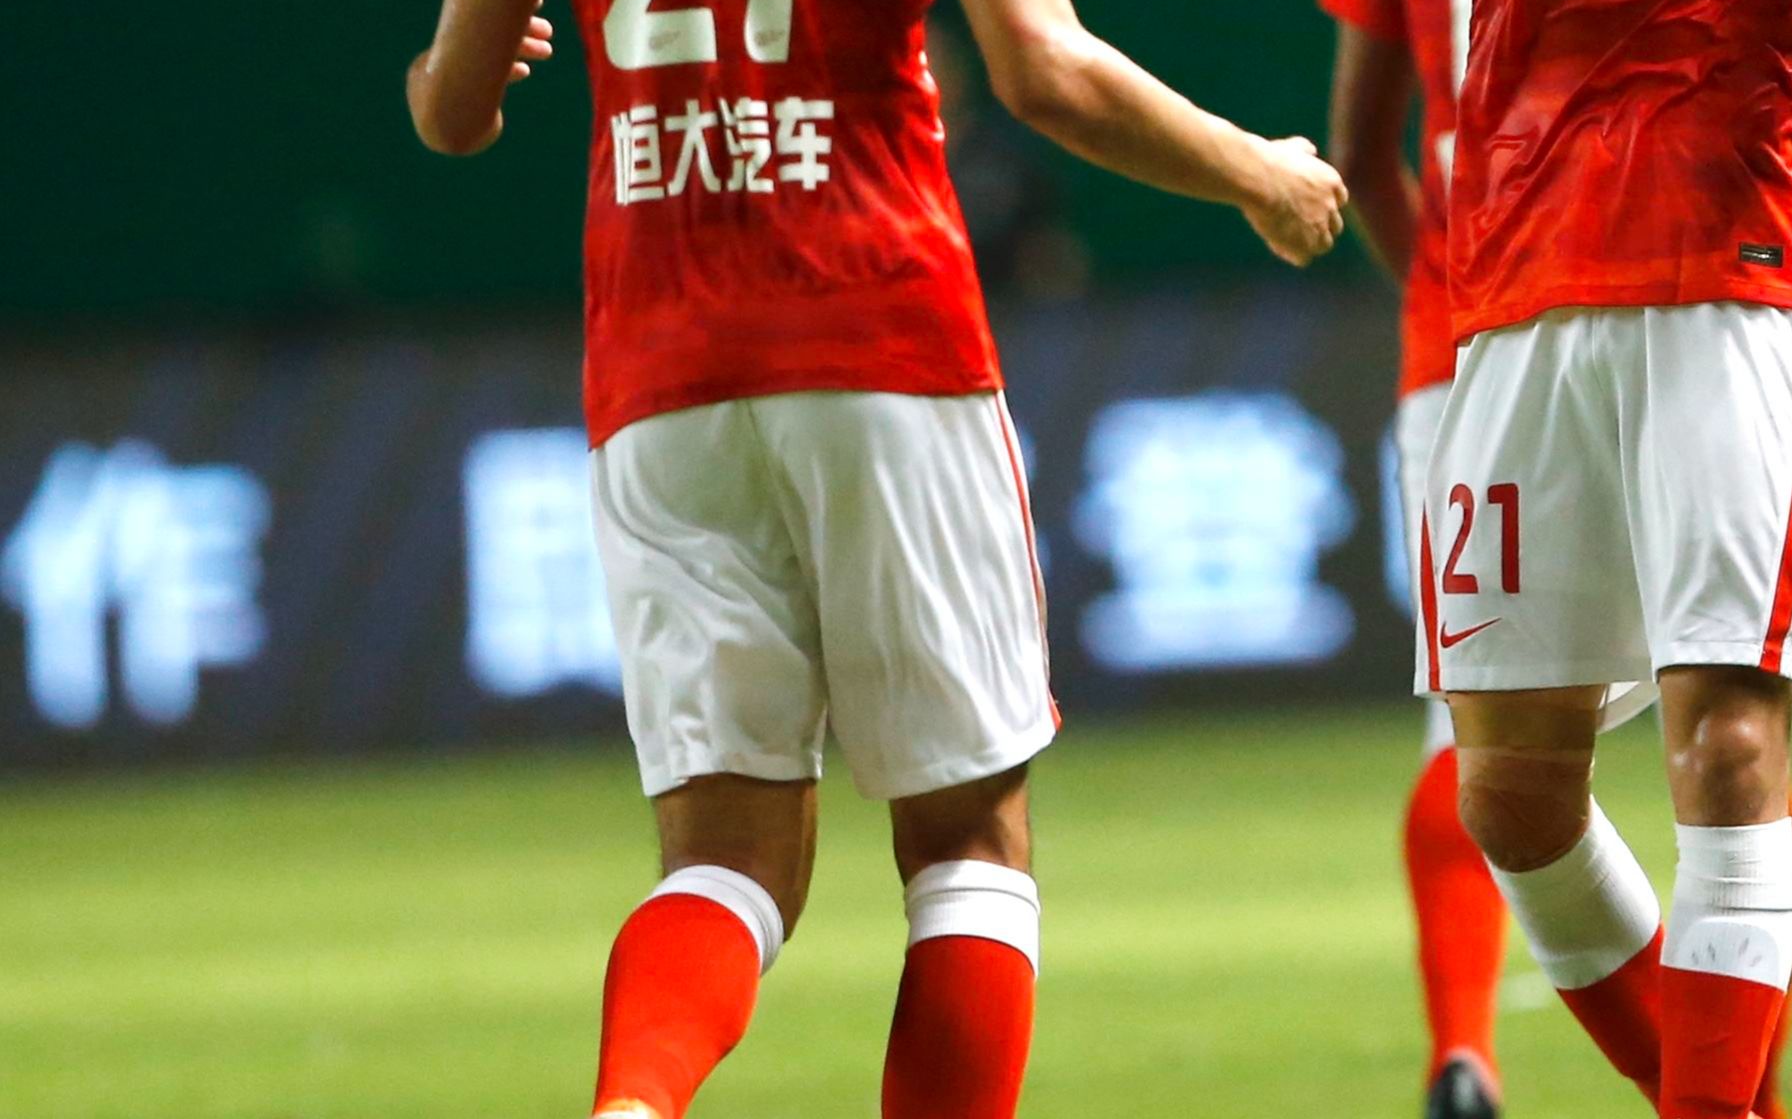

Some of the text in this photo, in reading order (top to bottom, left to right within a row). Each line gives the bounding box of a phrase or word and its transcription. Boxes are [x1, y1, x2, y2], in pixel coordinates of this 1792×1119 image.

[610, 96, 835, 206] 恒大汽车
[1442, 482, 1520, 595] 21
